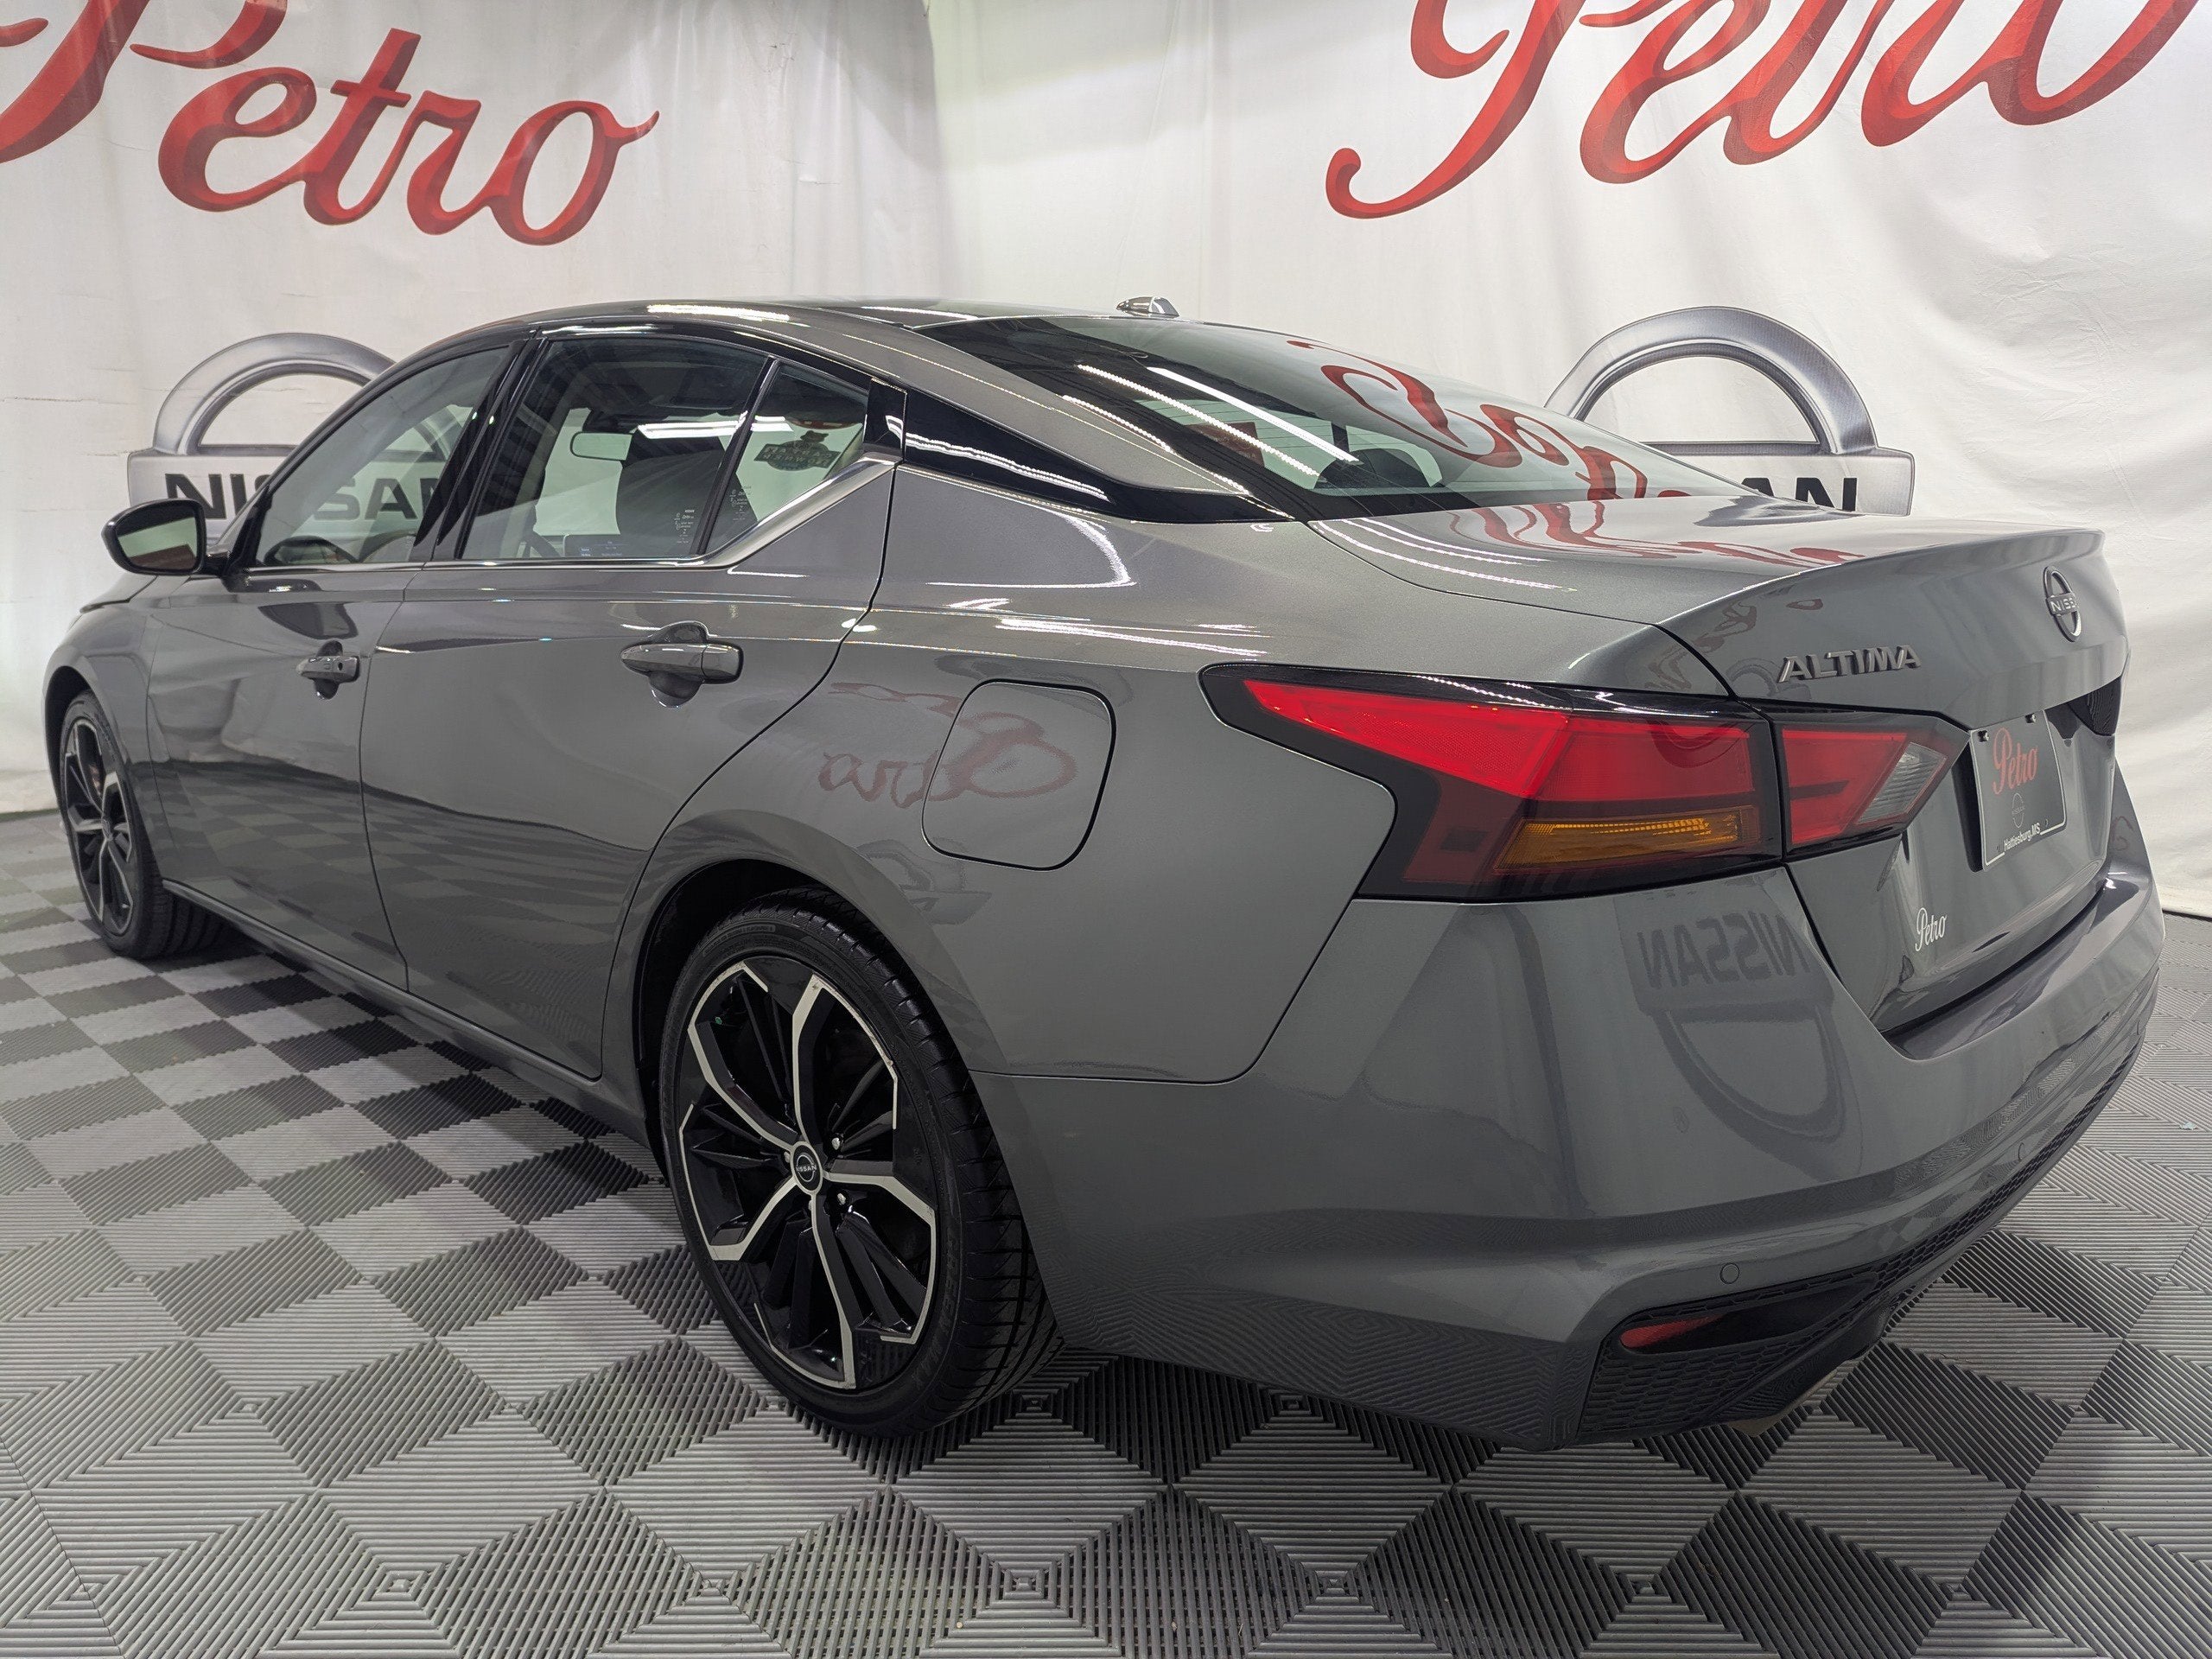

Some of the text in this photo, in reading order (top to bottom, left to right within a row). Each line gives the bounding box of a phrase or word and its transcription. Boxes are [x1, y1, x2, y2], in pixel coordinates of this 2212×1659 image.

[1777, 645, 1922, 683] ALTIMA
[1992, 727, 2038, 795] Petro
[1915, 907, 1948, 952] Petro
